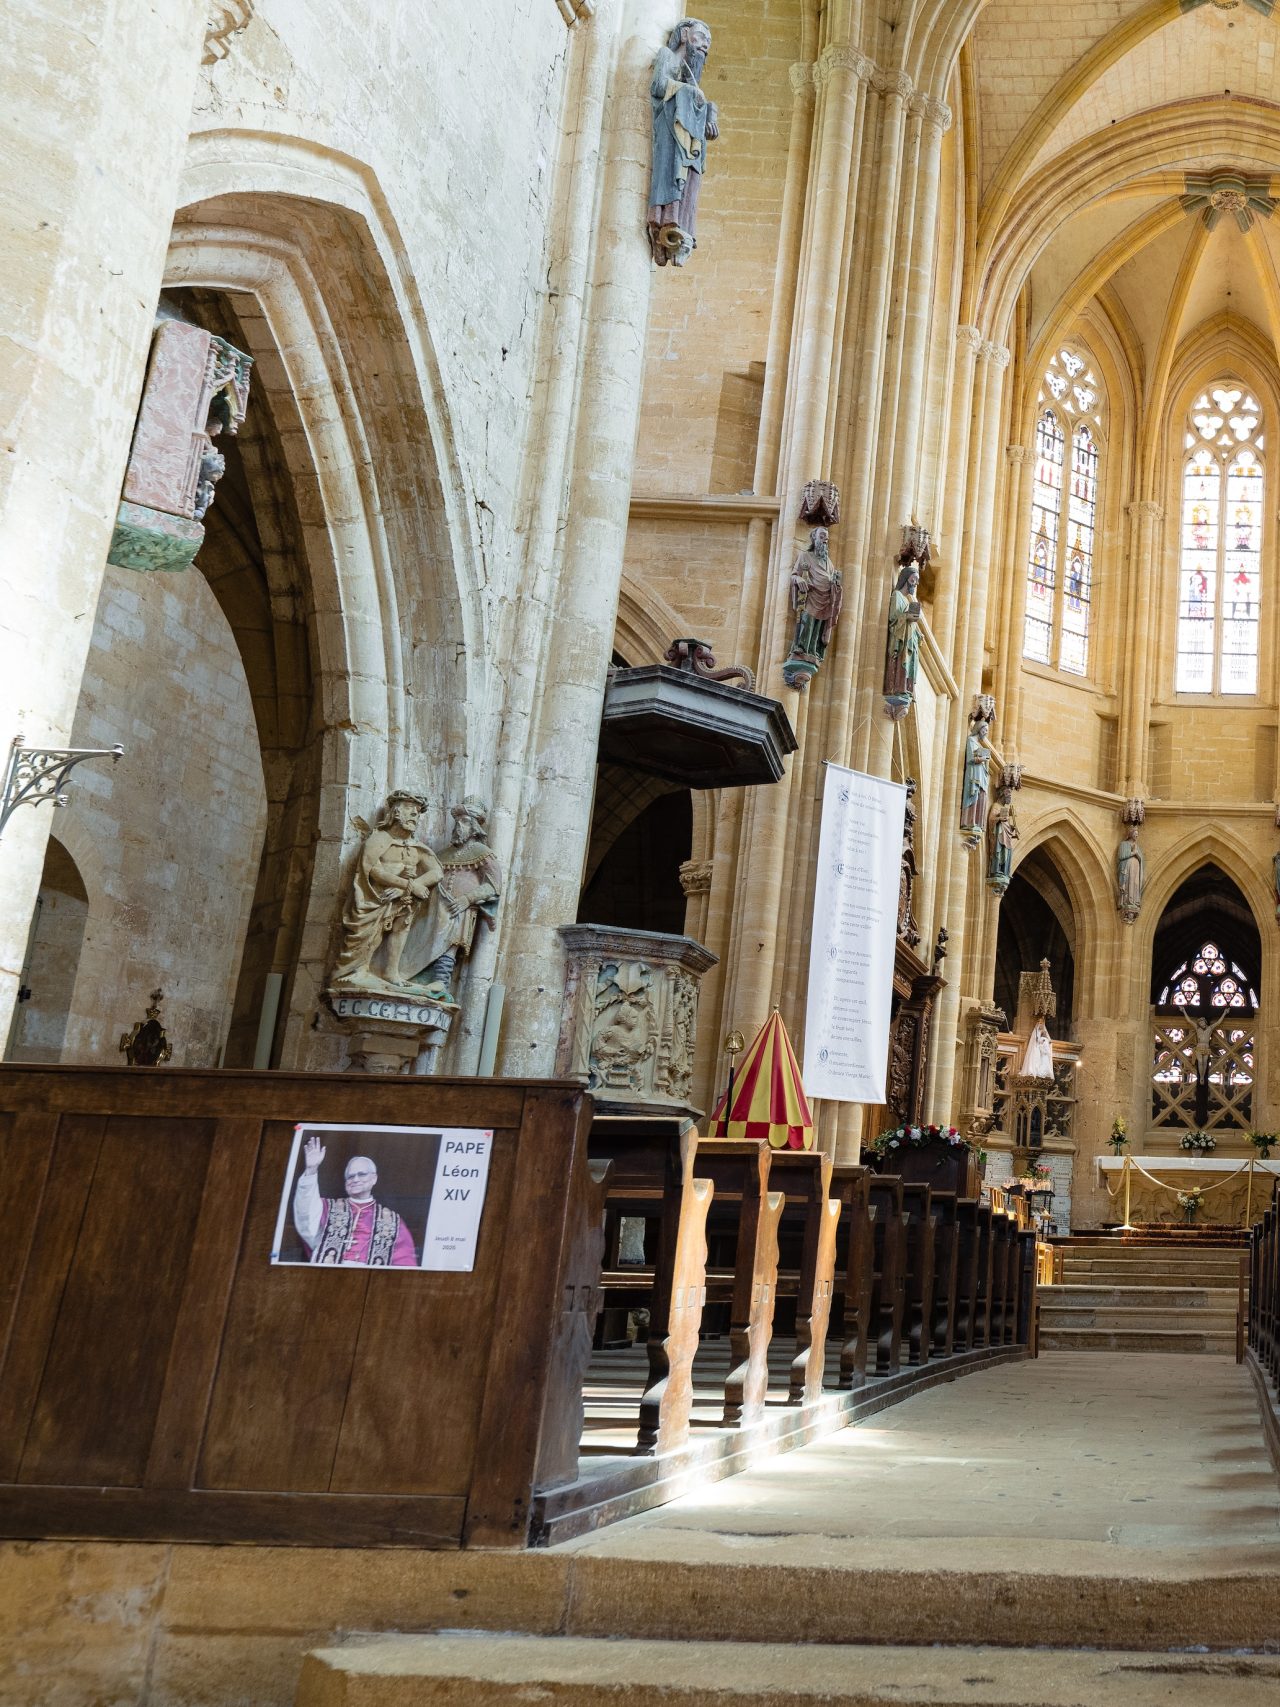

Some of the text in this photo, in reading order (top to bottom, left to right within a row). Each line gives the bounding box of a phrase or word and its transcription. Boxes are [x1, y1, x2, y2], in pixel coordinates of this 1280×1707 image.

[444, 1141, 486, 1155] PAPE
[442, 1164, 480, 1178] Léon
[443, 1188, 471, 1201] XIV
